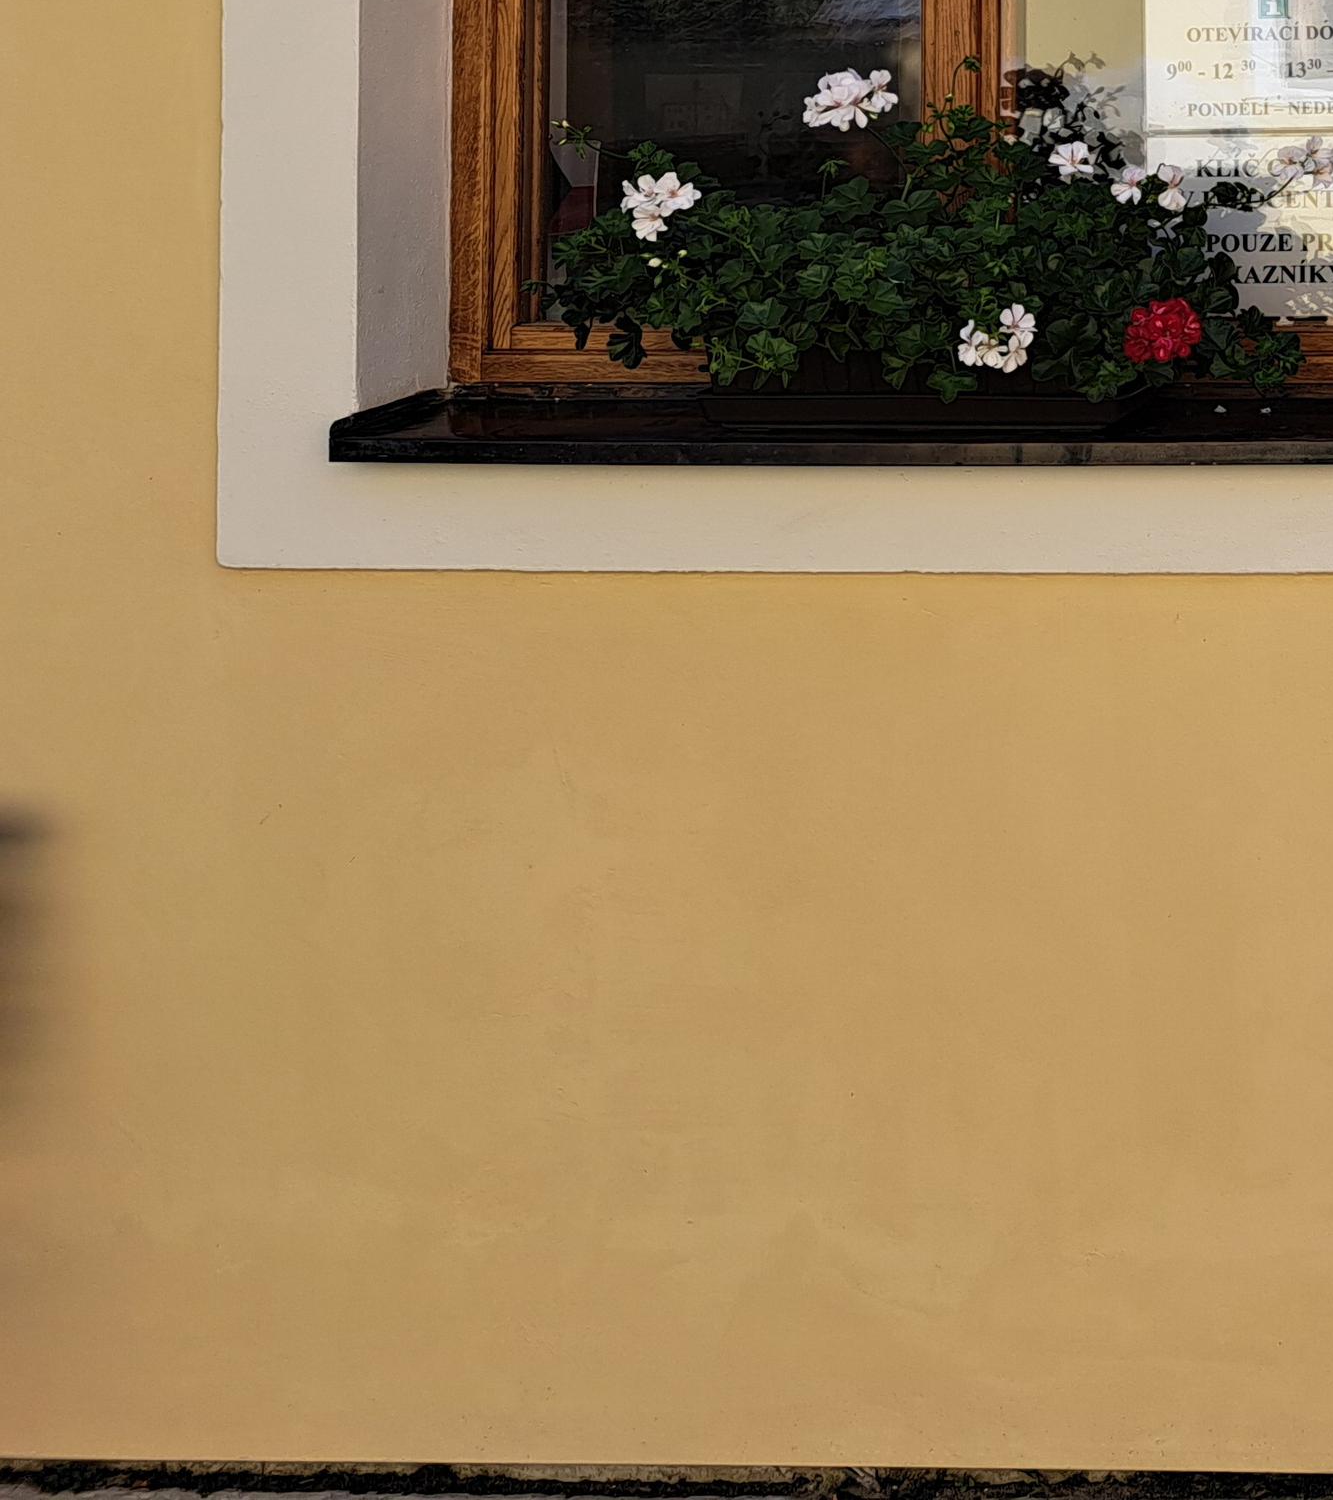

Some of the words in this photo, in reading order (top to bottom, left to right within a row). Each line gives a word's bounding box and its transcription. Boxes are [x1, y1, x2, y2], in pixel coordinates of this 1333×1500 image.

[1186, 21, 1300, 43] OTEVÍRACÍ
[1187, 98, 1269, 117] PONDĚLÍ
[1195, 152, 1261, 178] KLÍČ
[1206, 233, 1293, 253] POUZE
